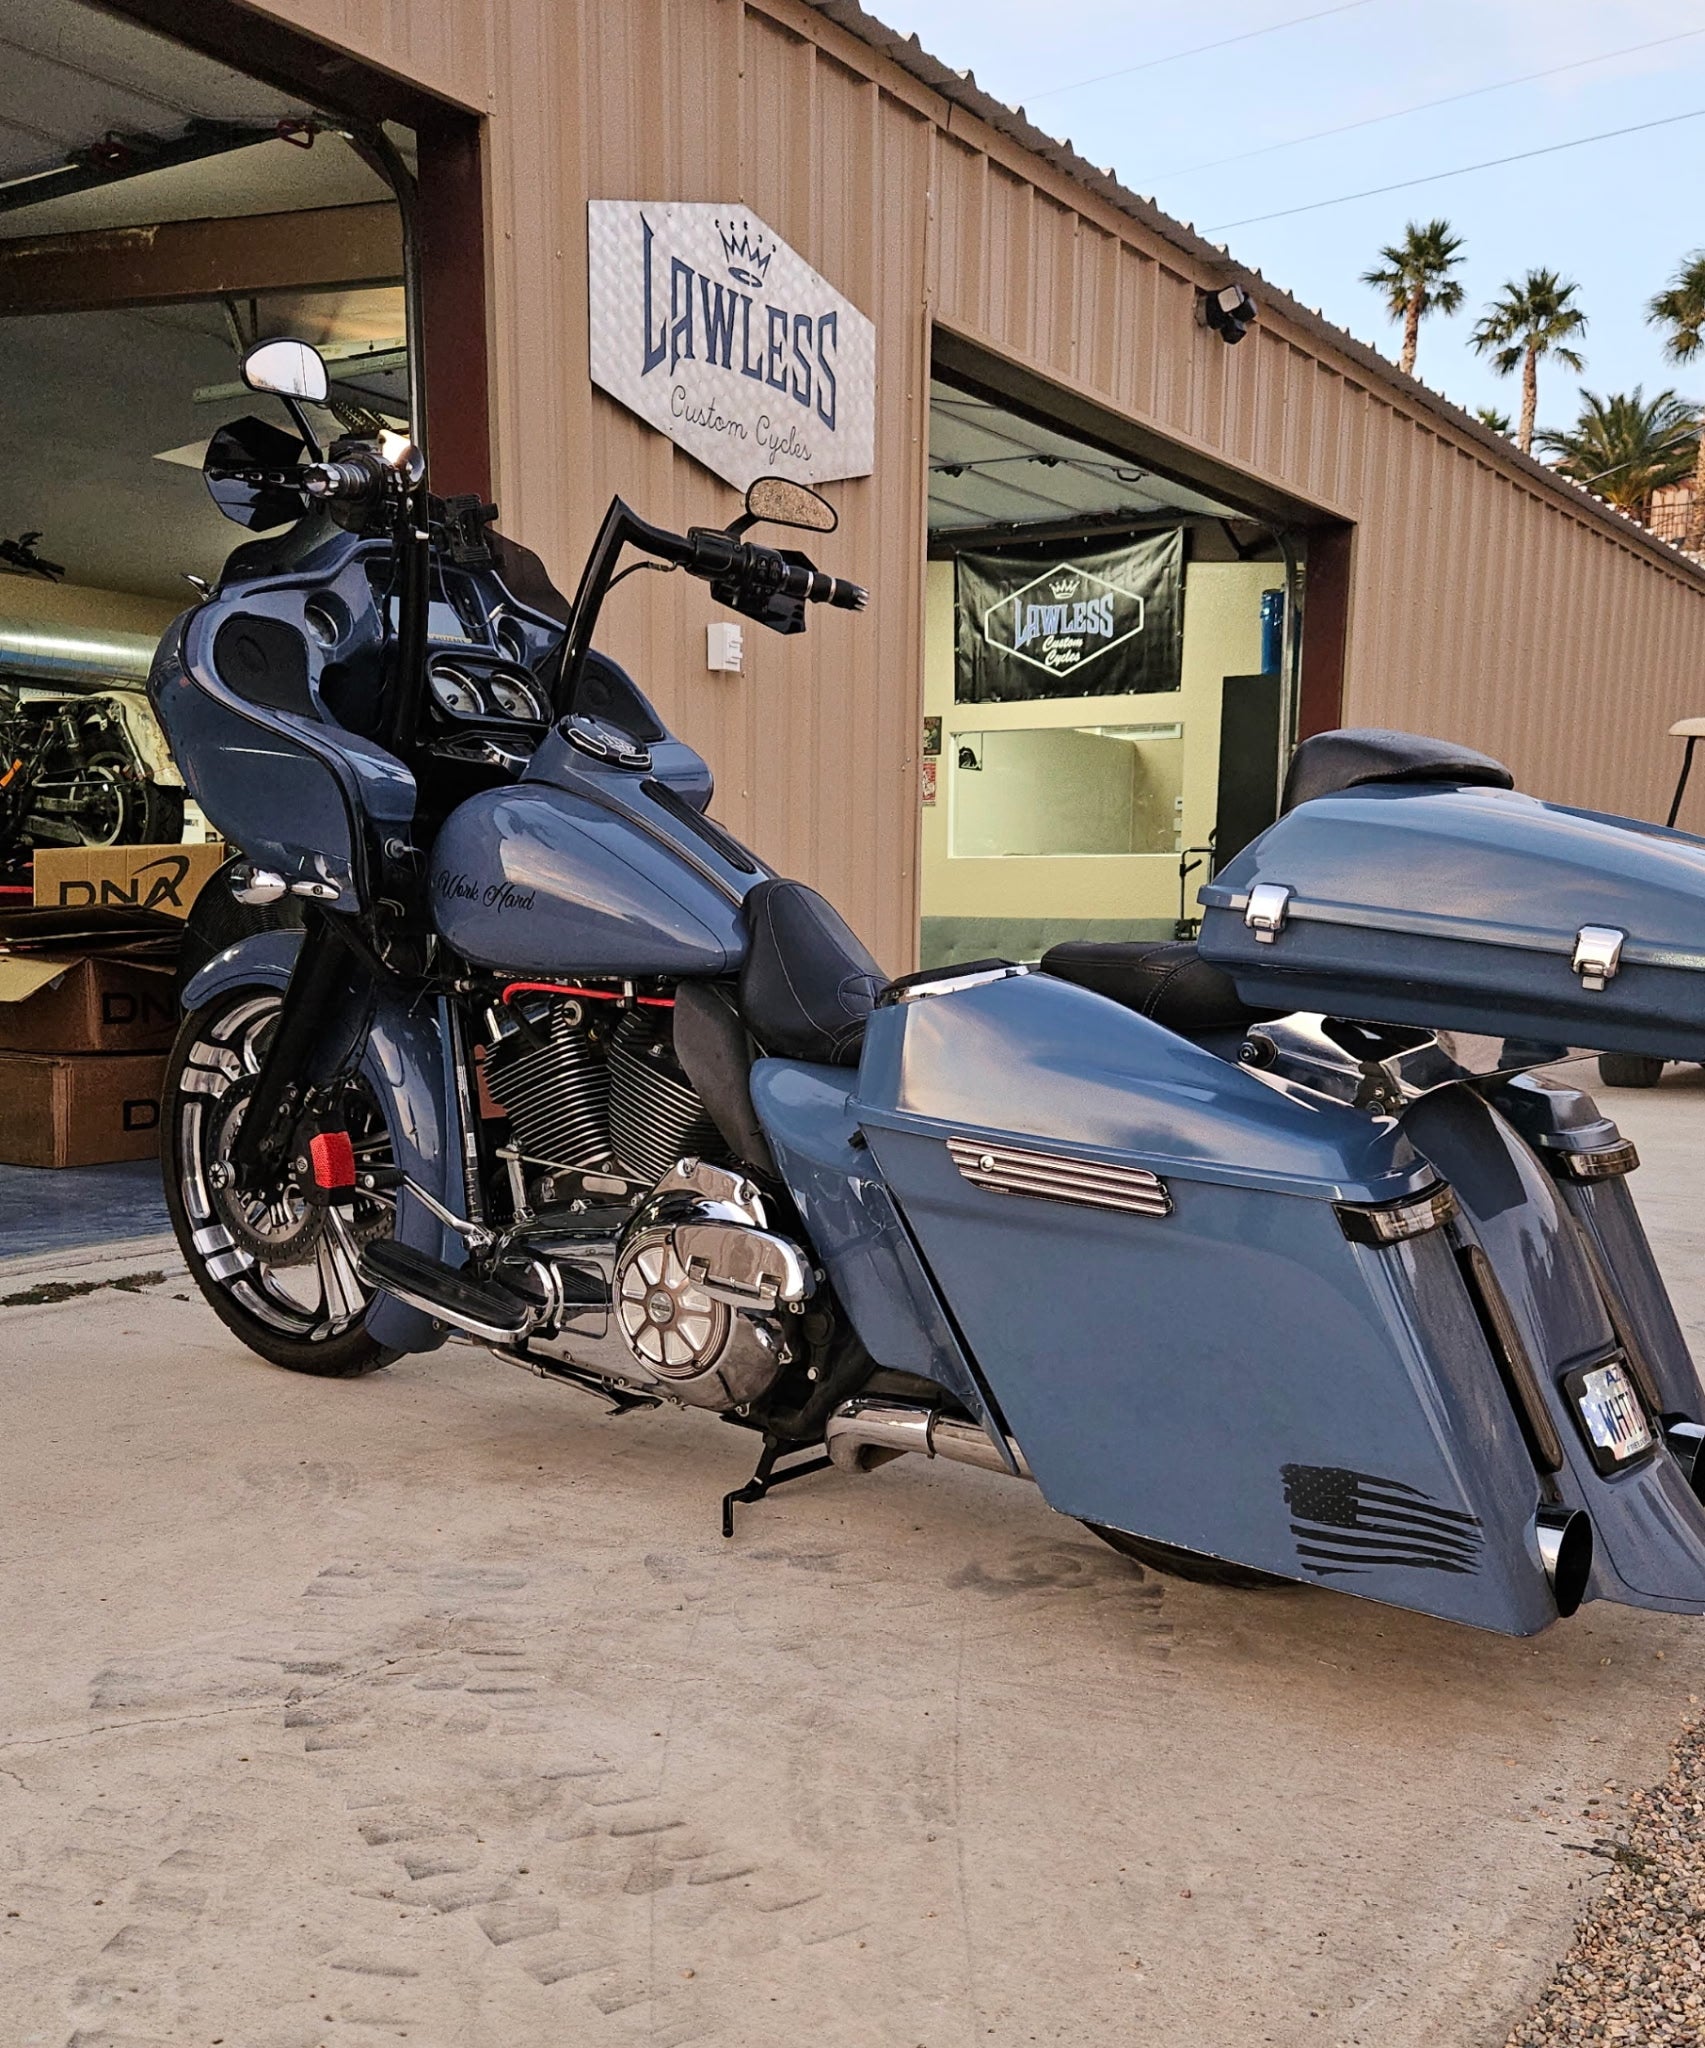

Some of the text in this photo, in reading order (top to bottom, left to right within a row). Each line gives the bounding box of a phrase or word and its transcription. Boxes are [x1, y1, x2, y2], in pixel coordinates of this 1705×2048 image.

[640, 211, 837, 432] LAWLESS
[670, 384, 812, 465] Custom Cycles
[1013, 592, 1114, 650] LAWLESS
[1042, 635, 1083, 652] Custom
[1044, 650, 1081, 667] Cycles
[59, 862, 187, 907] DNA
[438, 870, 536, 913] Work Hard
[103, 992, 177, 1024] DN
